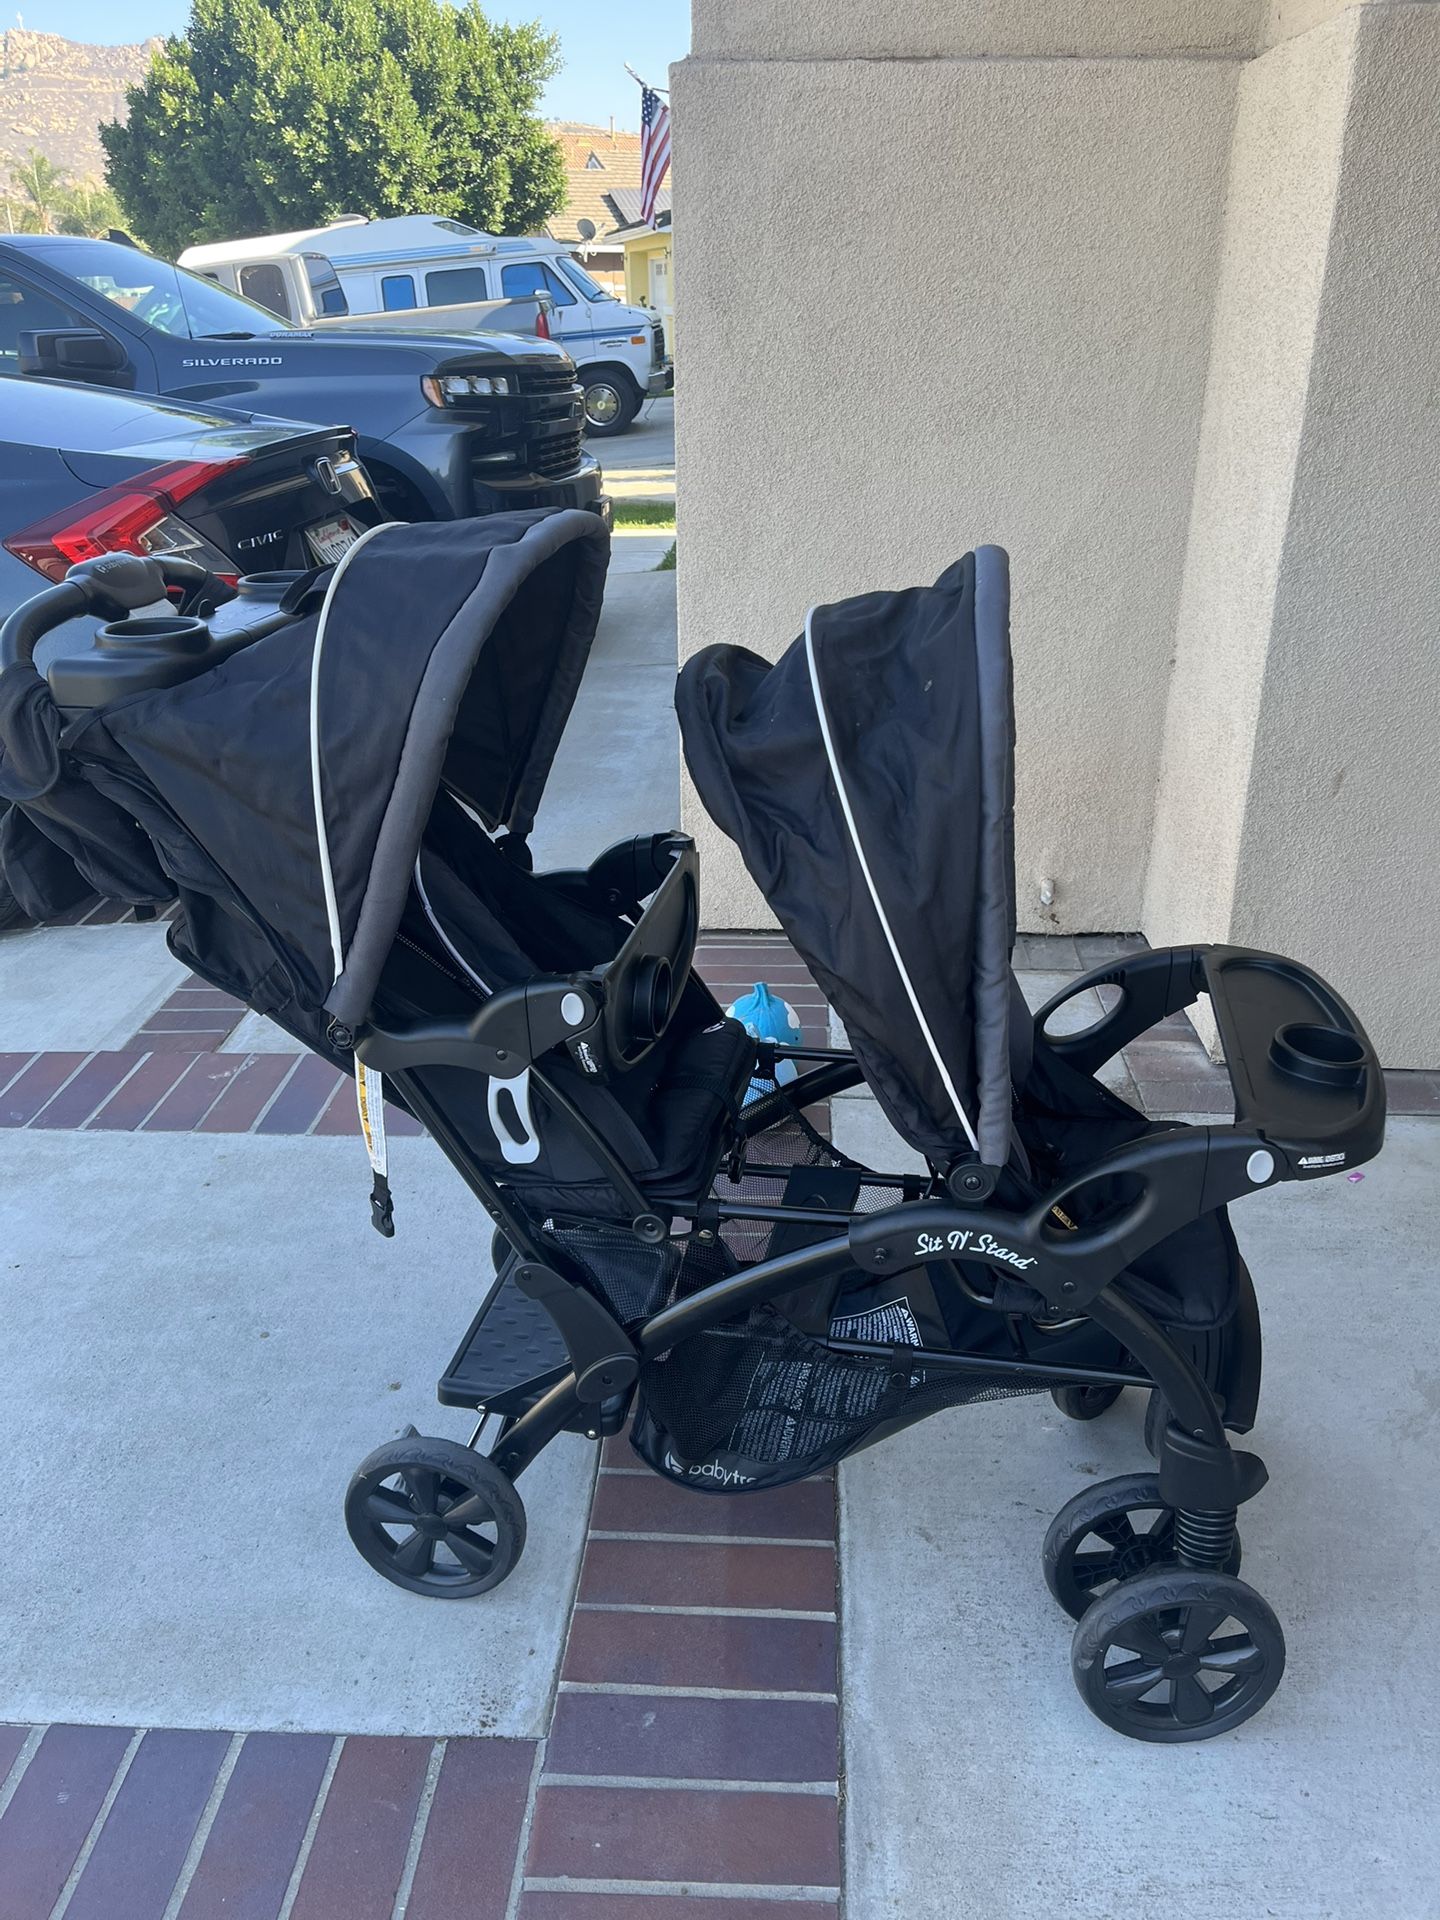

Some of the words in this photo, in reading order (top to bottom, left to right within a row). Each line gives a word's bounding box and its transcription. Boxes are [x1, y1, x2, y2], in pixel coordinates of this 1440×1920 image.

[182, 356, 283, 368] SILVERADO
[237, 529, 284, 550] CIVIC
[914, 1232, 945, 1256] Sit
[968, 1233, 1035, 1270] Stand
